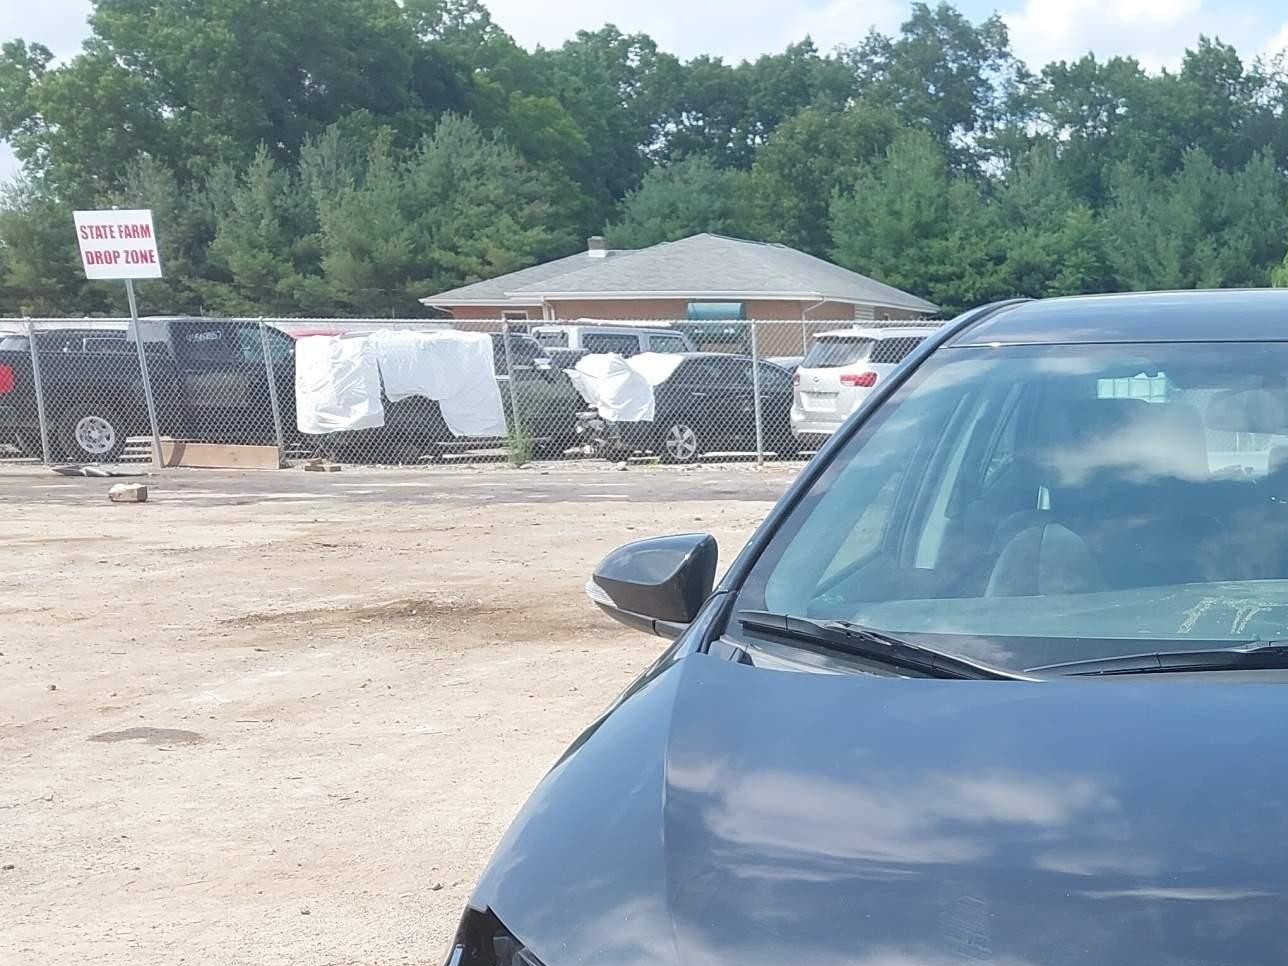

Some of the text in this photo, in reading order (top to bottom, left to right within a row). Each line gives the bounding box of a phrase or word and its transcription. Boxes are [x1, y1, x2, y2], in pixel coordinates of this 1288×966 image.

[79, 224, 152, 240] STATE FARM
[85, 249, 157, 265] DROP ZONE
